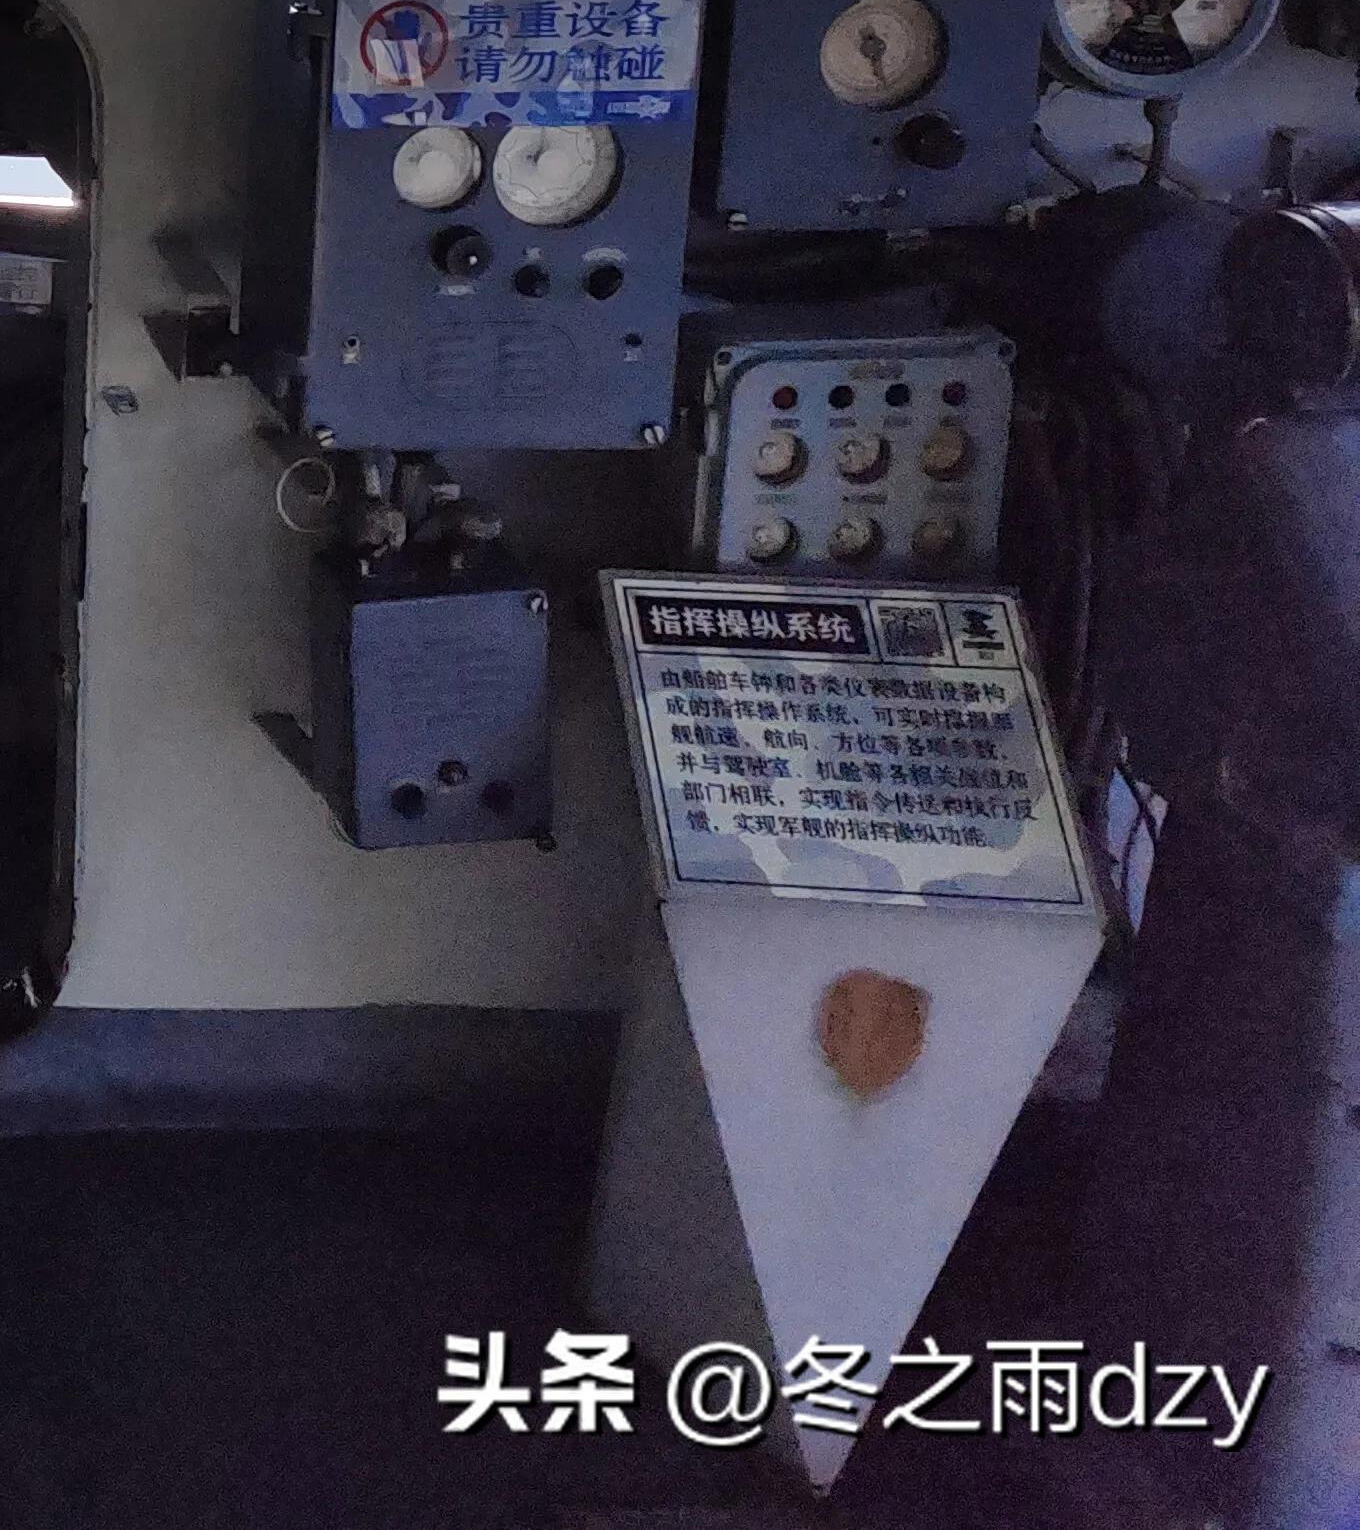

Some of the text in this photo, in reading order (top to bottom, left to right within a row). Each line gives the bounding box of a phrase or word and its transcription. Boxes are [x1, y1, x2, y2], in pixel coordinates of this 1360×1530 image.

[460, 0, 671, 40] 贵重设备
[456, 43, 666, 83] 请勿触碰
[648, 604, 857, 645] 指挥操纵系统
